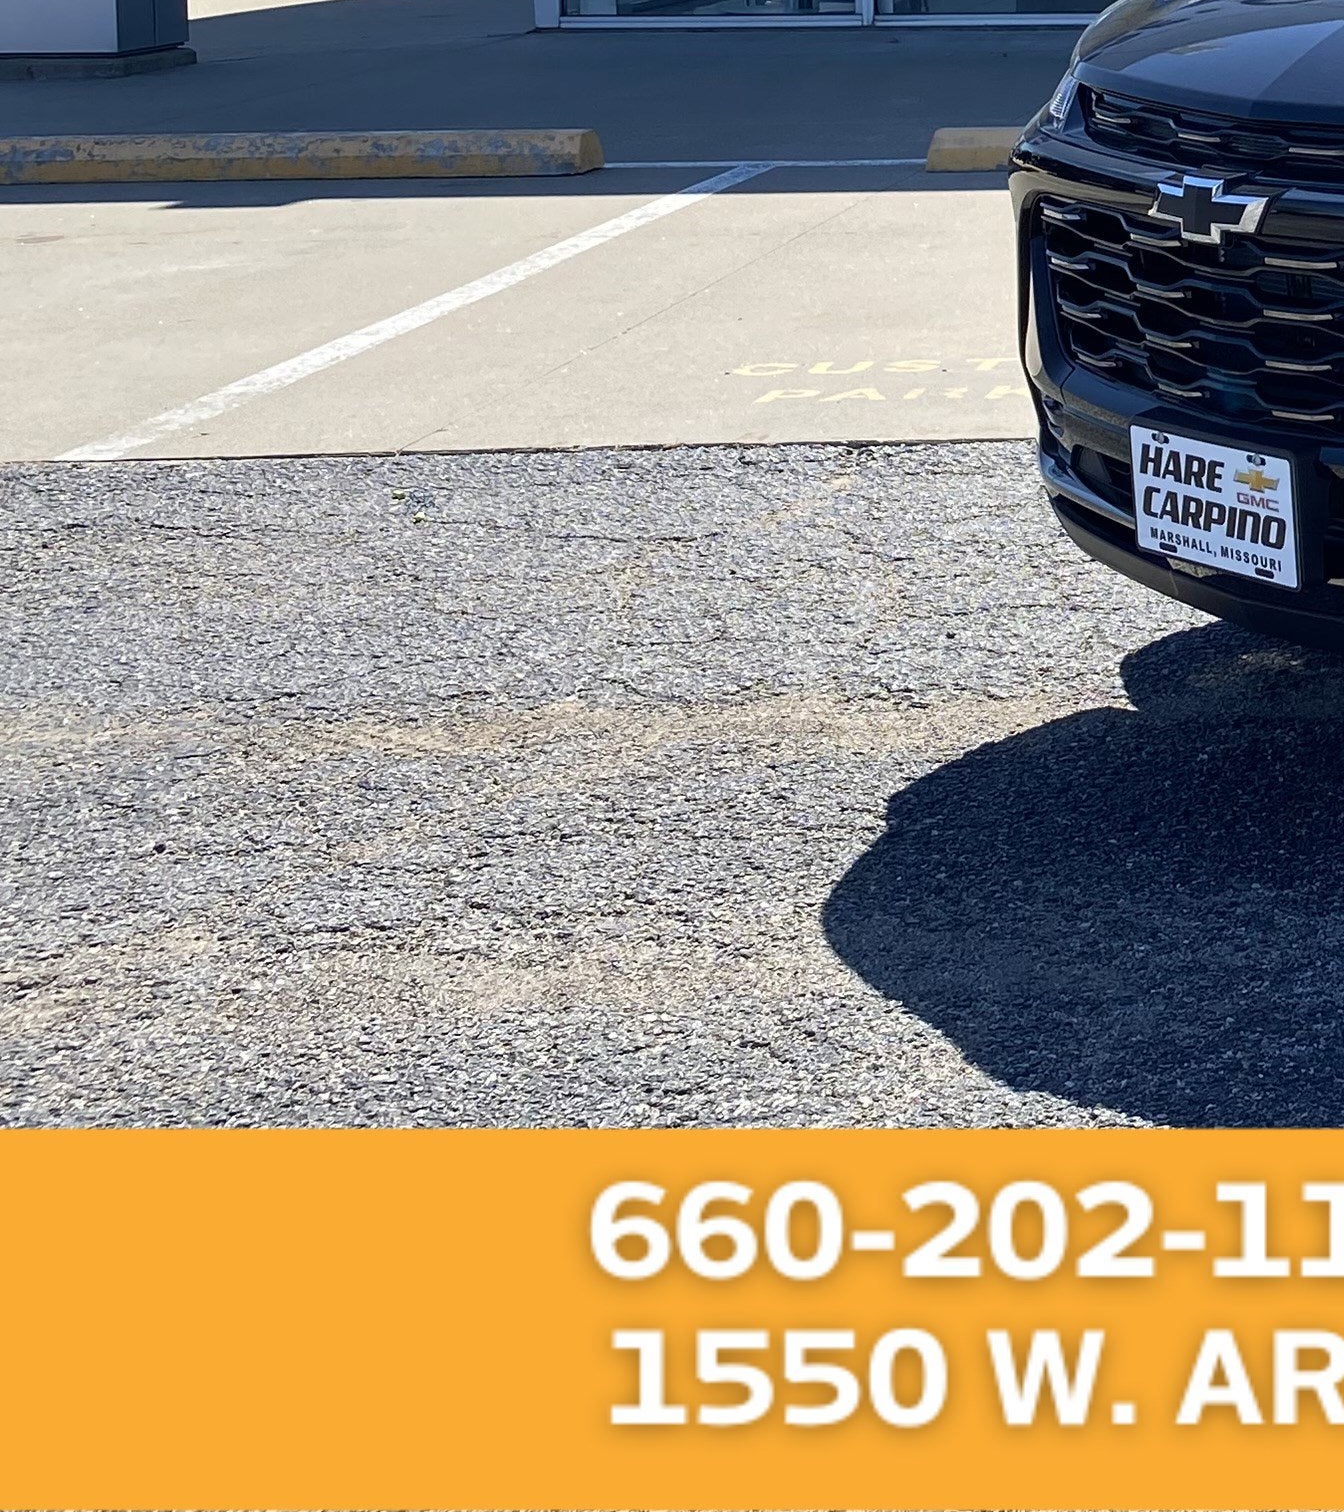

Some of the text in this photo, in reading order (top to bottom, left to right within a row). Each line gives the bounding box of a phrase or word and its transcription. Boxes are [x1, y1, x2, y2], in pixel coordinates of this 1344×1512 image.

[1139, 443, 1225, 494] HARE
[1142, 485, 1287, 551] CARPINO
[1236, 491, 1280, 513] GMC
[1150, 526, 1283, 573] MARSHALL, MISSOURI
